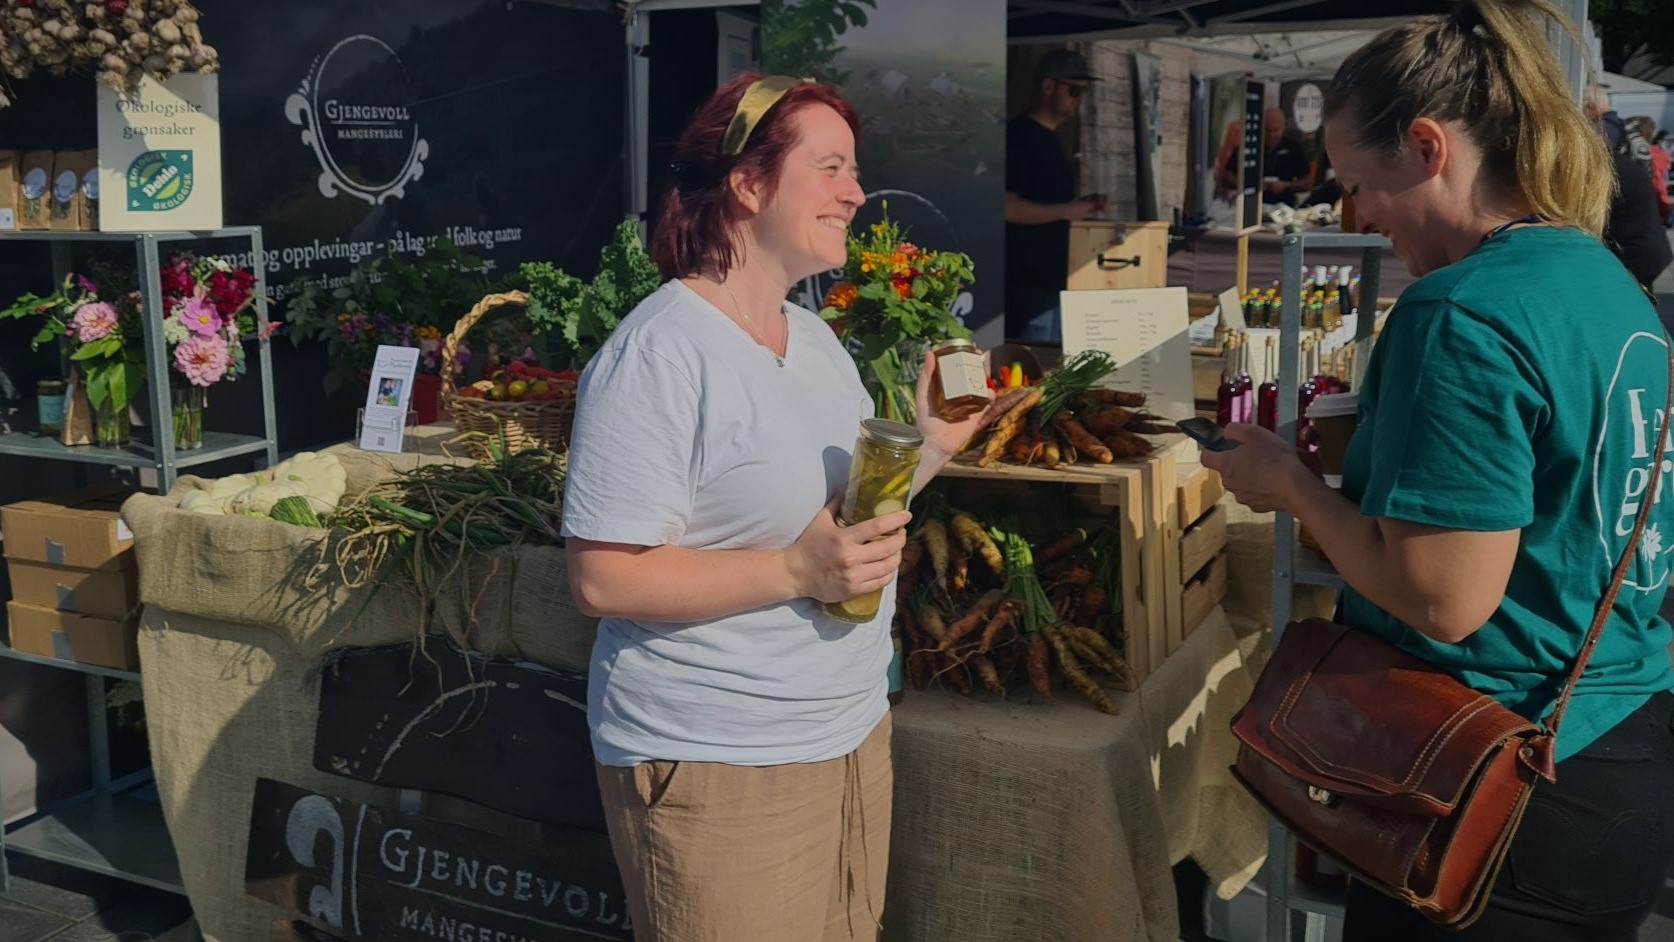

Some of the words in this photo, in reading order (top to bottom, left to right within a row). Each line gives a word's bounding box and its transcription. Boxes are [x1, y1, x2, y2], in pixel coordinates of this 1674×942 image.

[115, 99, 203, 117] Økologiske
[324, 99, 410, 123] GJENGEVOLL
[123, 123, 196, 139] grønsaker
[282, 237, 374, 269] opplevingar
[404, 231, 425, 257] lag
[453, 225, 478, 247] folk
[478, 229, 495, 250] og
[495, 227, 522, 243] natur
